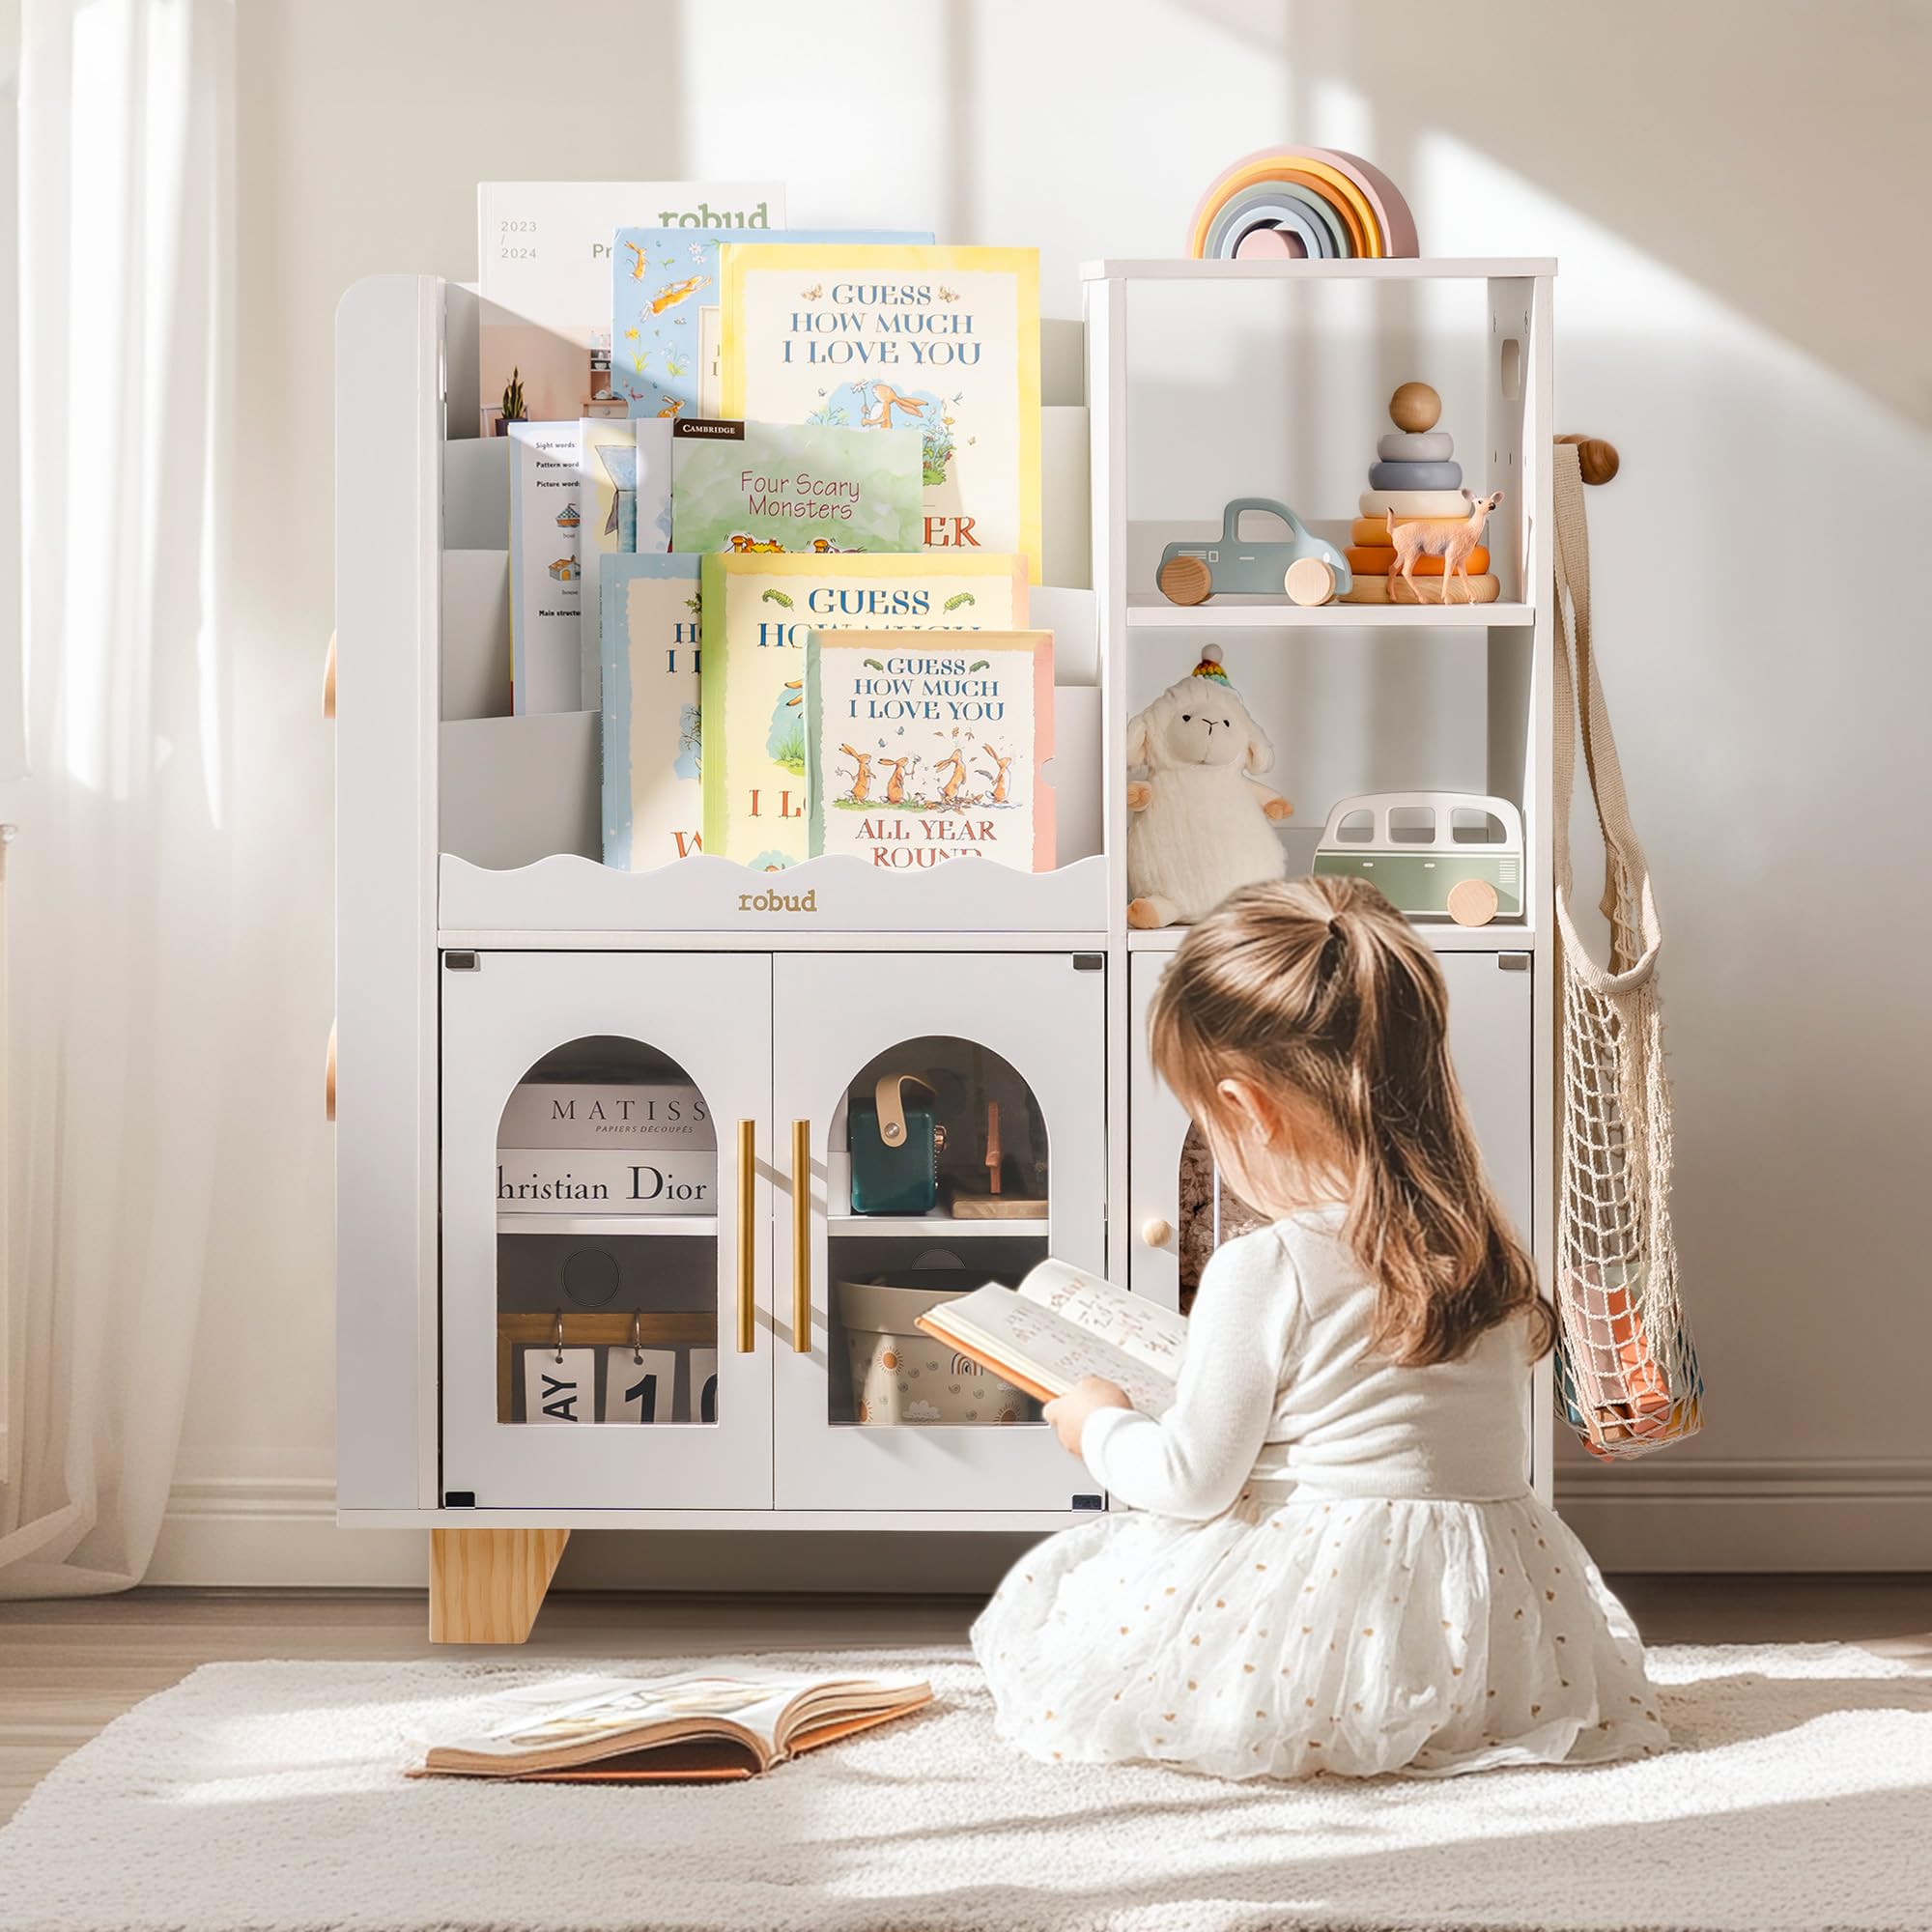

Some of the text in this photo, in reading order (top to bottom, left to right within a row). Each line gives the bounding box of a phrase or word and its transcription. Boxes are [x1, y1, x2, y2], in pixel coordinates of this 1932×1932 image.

[500, 221, 537, 232] 2023
[658, 202, 771, 229] robud
[500, 247, 537, 259] 2024
[832, 284, 932, 305] GUESS
[789, 312, 974, 334] HOW MUCH
[781, 340, 982, 365] I LOVE YOU
[682, 424, 736, 434] CAMBRIDGE
[535, 441, 554, 450] Sight
[741, 469, 861, 502] Four Scary
[748, 495, 853, 520] Monsters
[923, 516, 981, 548] ER
[808, 587, 931, 615] GUESS
[672, 623, 702, 644] H
[666, 649, 678, 673] I
[886, 658, 967, 675] GUESS
[853, 679, 1000, 696] HOW MUCH
[848, 699, 1006, 721] I LOVE YOU
[748, 789, 807, 819] I L
[854, 818, 998, 841] ALL YEAR
[738, 889, 818, 912] robud
[551, 1099, 706, 1122] MATISS
[595, 1124, 638, 1133] PAPIERS
[626, 1165, 708, 1201] Dior
[541, 1374, 579, 1423] AY
[625, 1374, 658, 1424] 1
